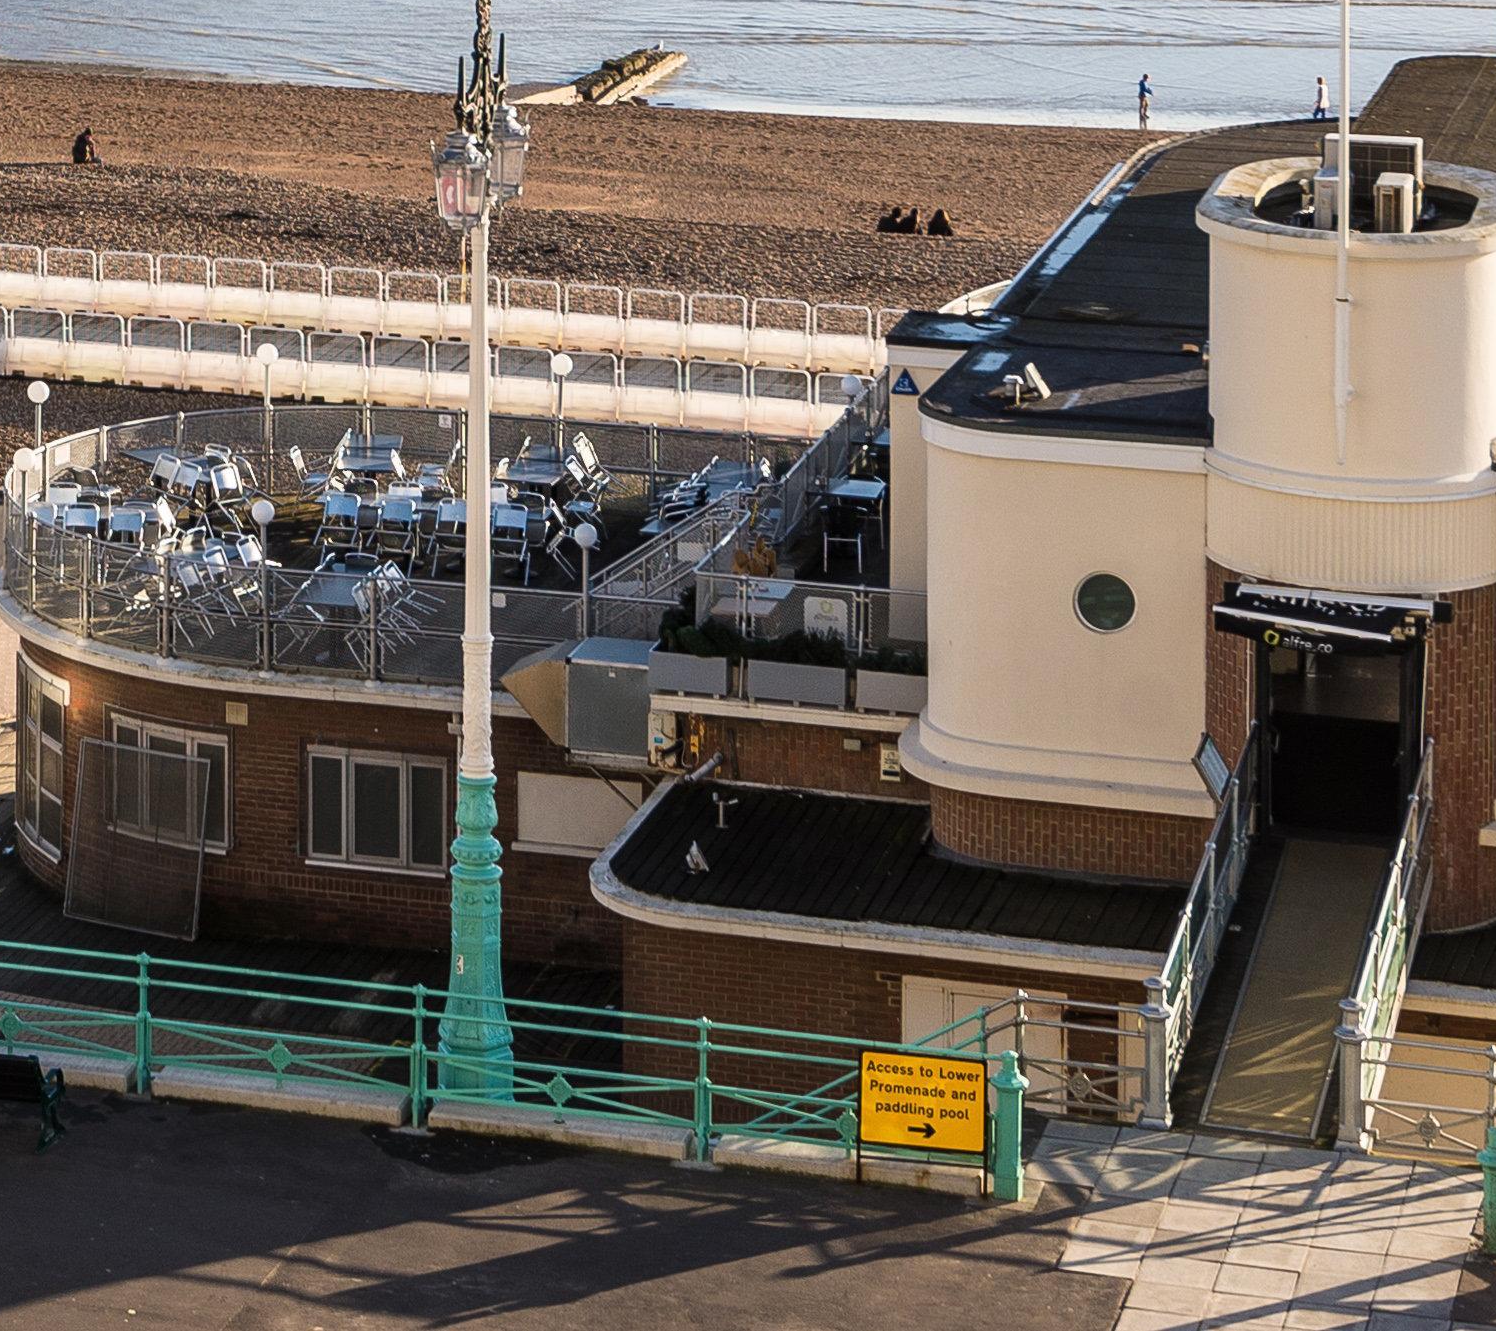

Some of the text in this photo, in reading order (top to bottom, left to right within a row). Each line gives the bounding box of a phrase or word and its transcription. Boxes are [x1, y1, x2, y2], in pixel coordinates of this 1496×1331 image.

[1282, 636, 1333, 654] alfreco
[866, 1060, 980, 1083] Access to Lower
[870, 1079, 976, 1102] Promenade and
[875, 1101, 970, 1120] paddling pool
